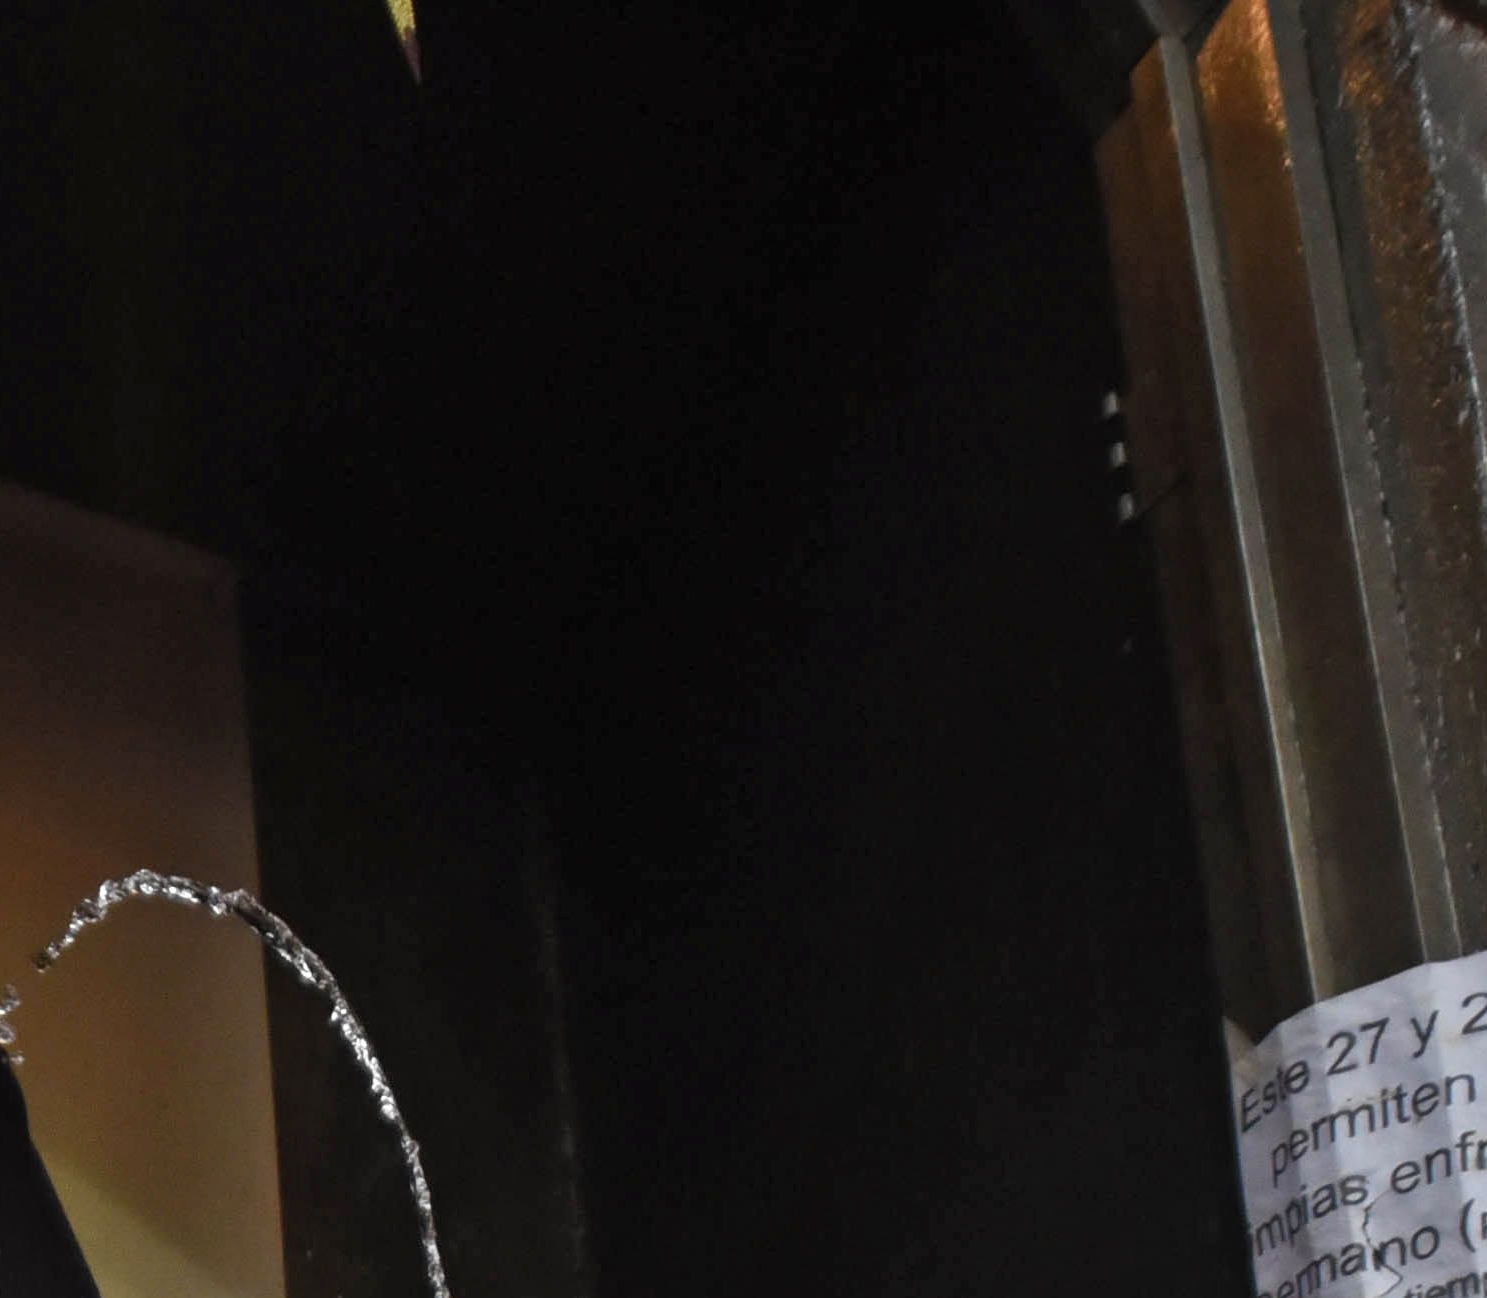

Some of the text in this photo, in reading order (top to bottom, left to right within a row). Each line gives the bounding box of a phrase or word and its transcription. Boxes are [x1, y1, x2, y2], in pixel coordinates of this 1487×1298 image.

[1241, 1060, 1311, 1132] Este
[1325, 1014, 1389, 1077] 27
[1410, 1010, 1441, 1060] y
[1271, 1073, 1477, 1188] permiten
[1256, 1173, 1370, 1257] mpias
